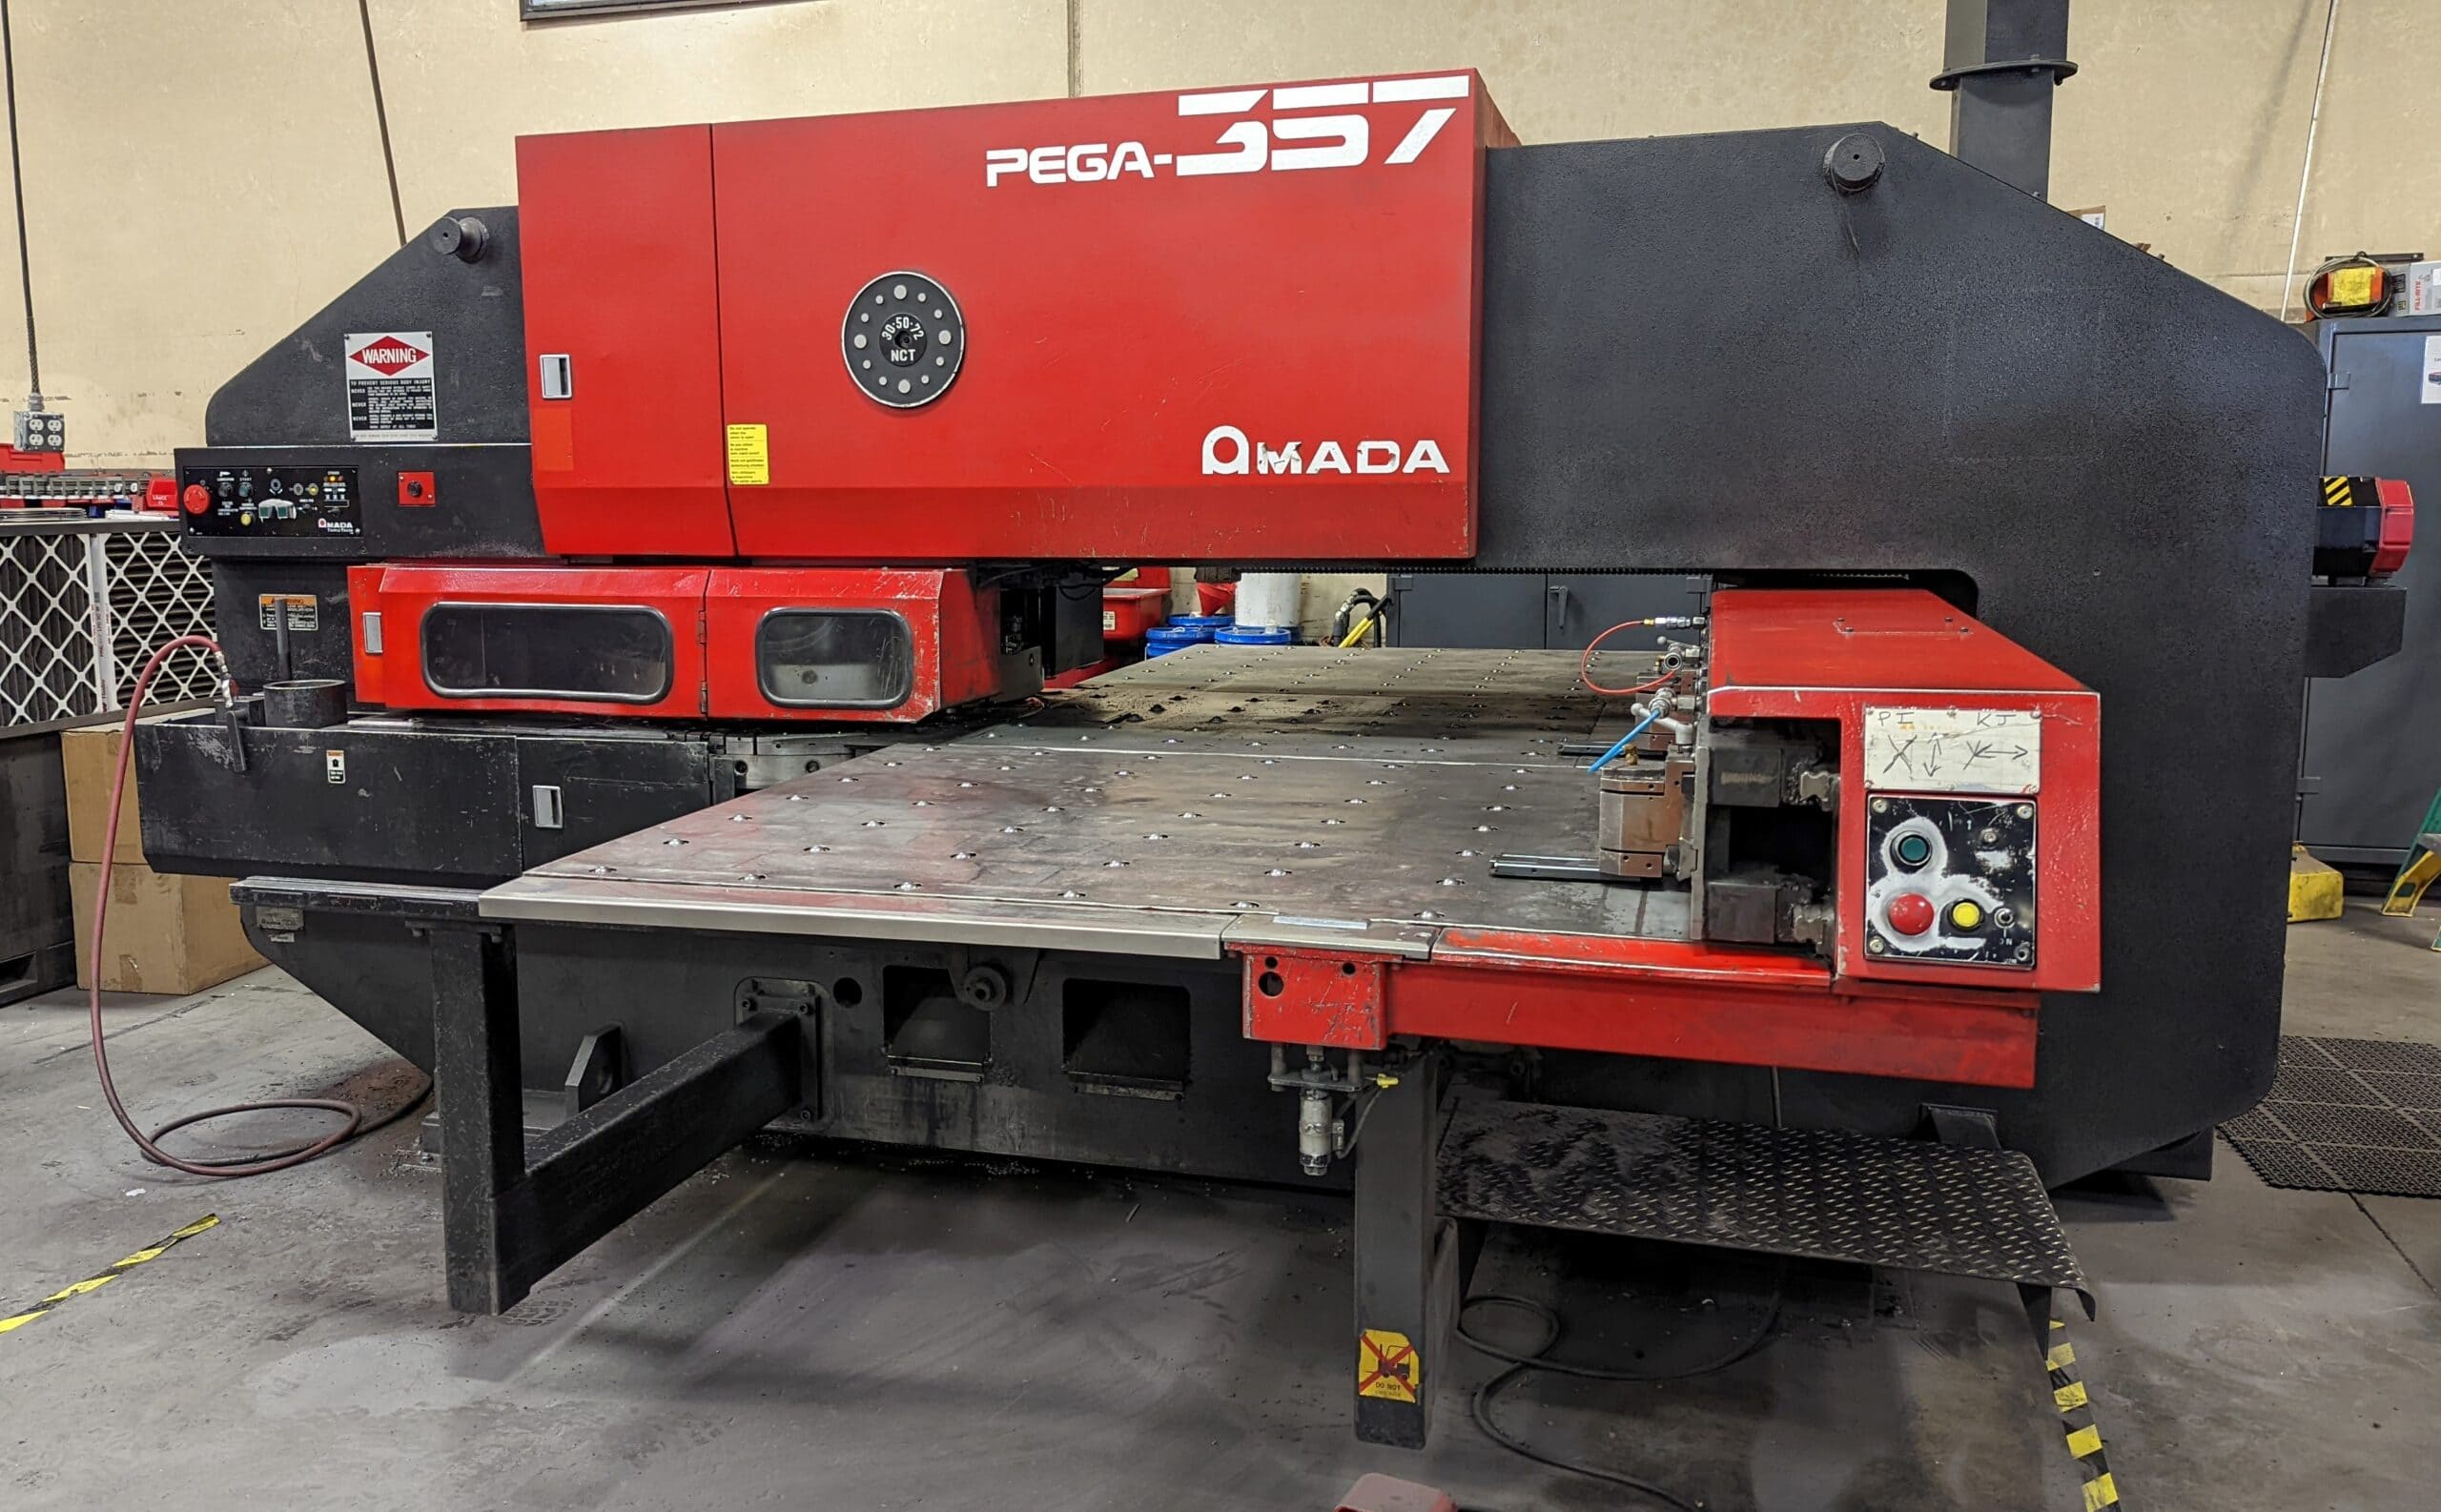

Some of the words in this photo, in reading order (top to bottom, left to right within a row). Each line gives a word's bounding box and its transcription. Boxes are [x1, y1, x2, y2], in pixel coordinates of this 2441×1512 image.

[985, 75, 1470, 188] PEGA-357
[362, 348, 417, 364] WARNING
[891, 349, 916, 362] NCT
[1201, 425, 1451, 475] AMADA
[1882, 734, 1918, 774] X
